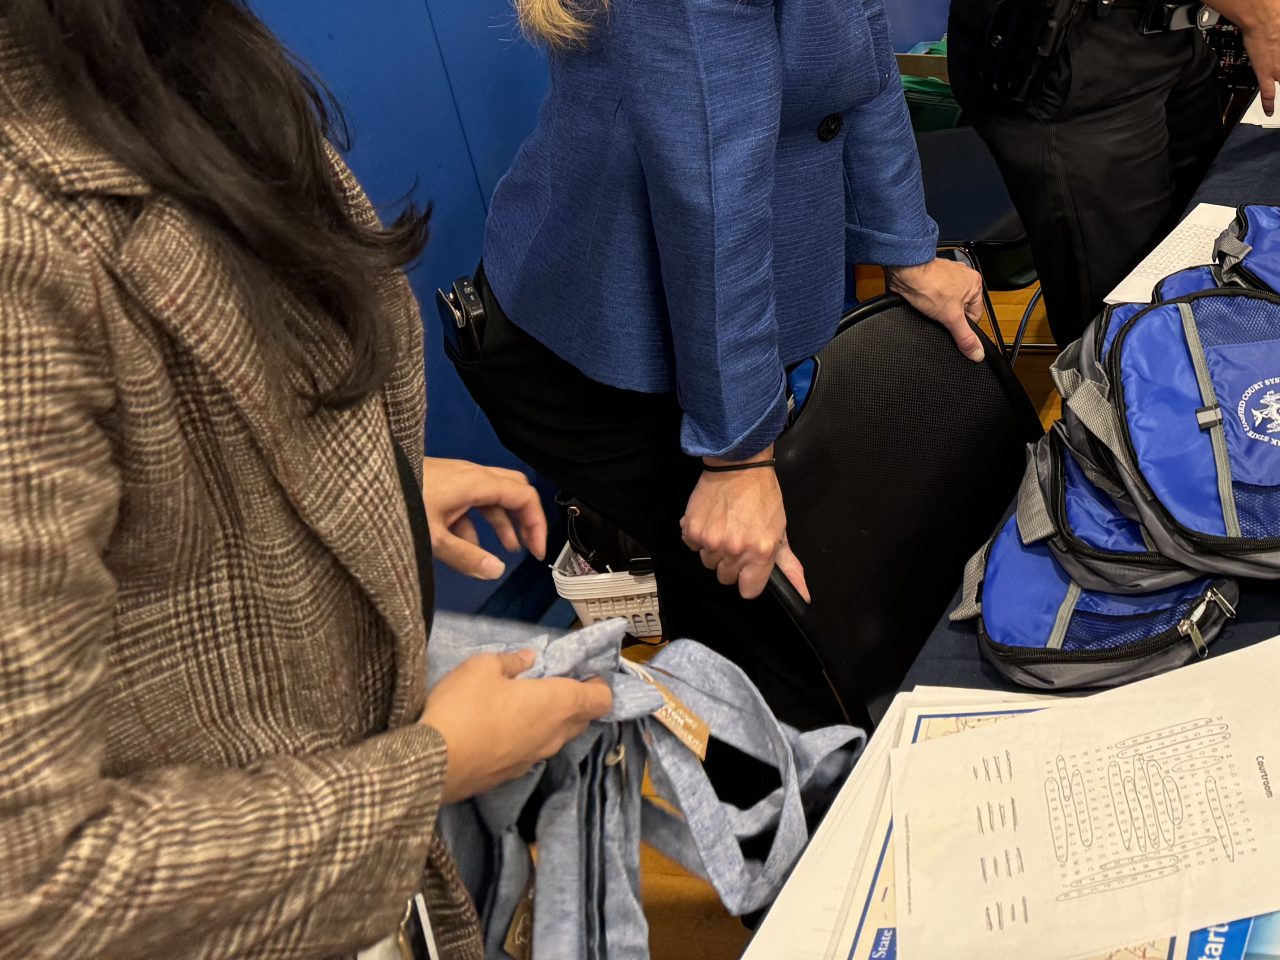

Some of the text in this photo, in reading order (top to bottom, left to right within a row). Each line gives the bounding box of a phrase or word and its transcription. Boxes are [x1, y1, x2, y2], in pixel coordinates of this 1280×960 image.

[1242, 381, 1263, 401] COURT
[1237, 400, 1249, 431] UNIFIED
[1246, 429, 1269, 442] STATE
[1256, 755, 1273, 798] Courtroom
[872, 927, 892, 960] State
